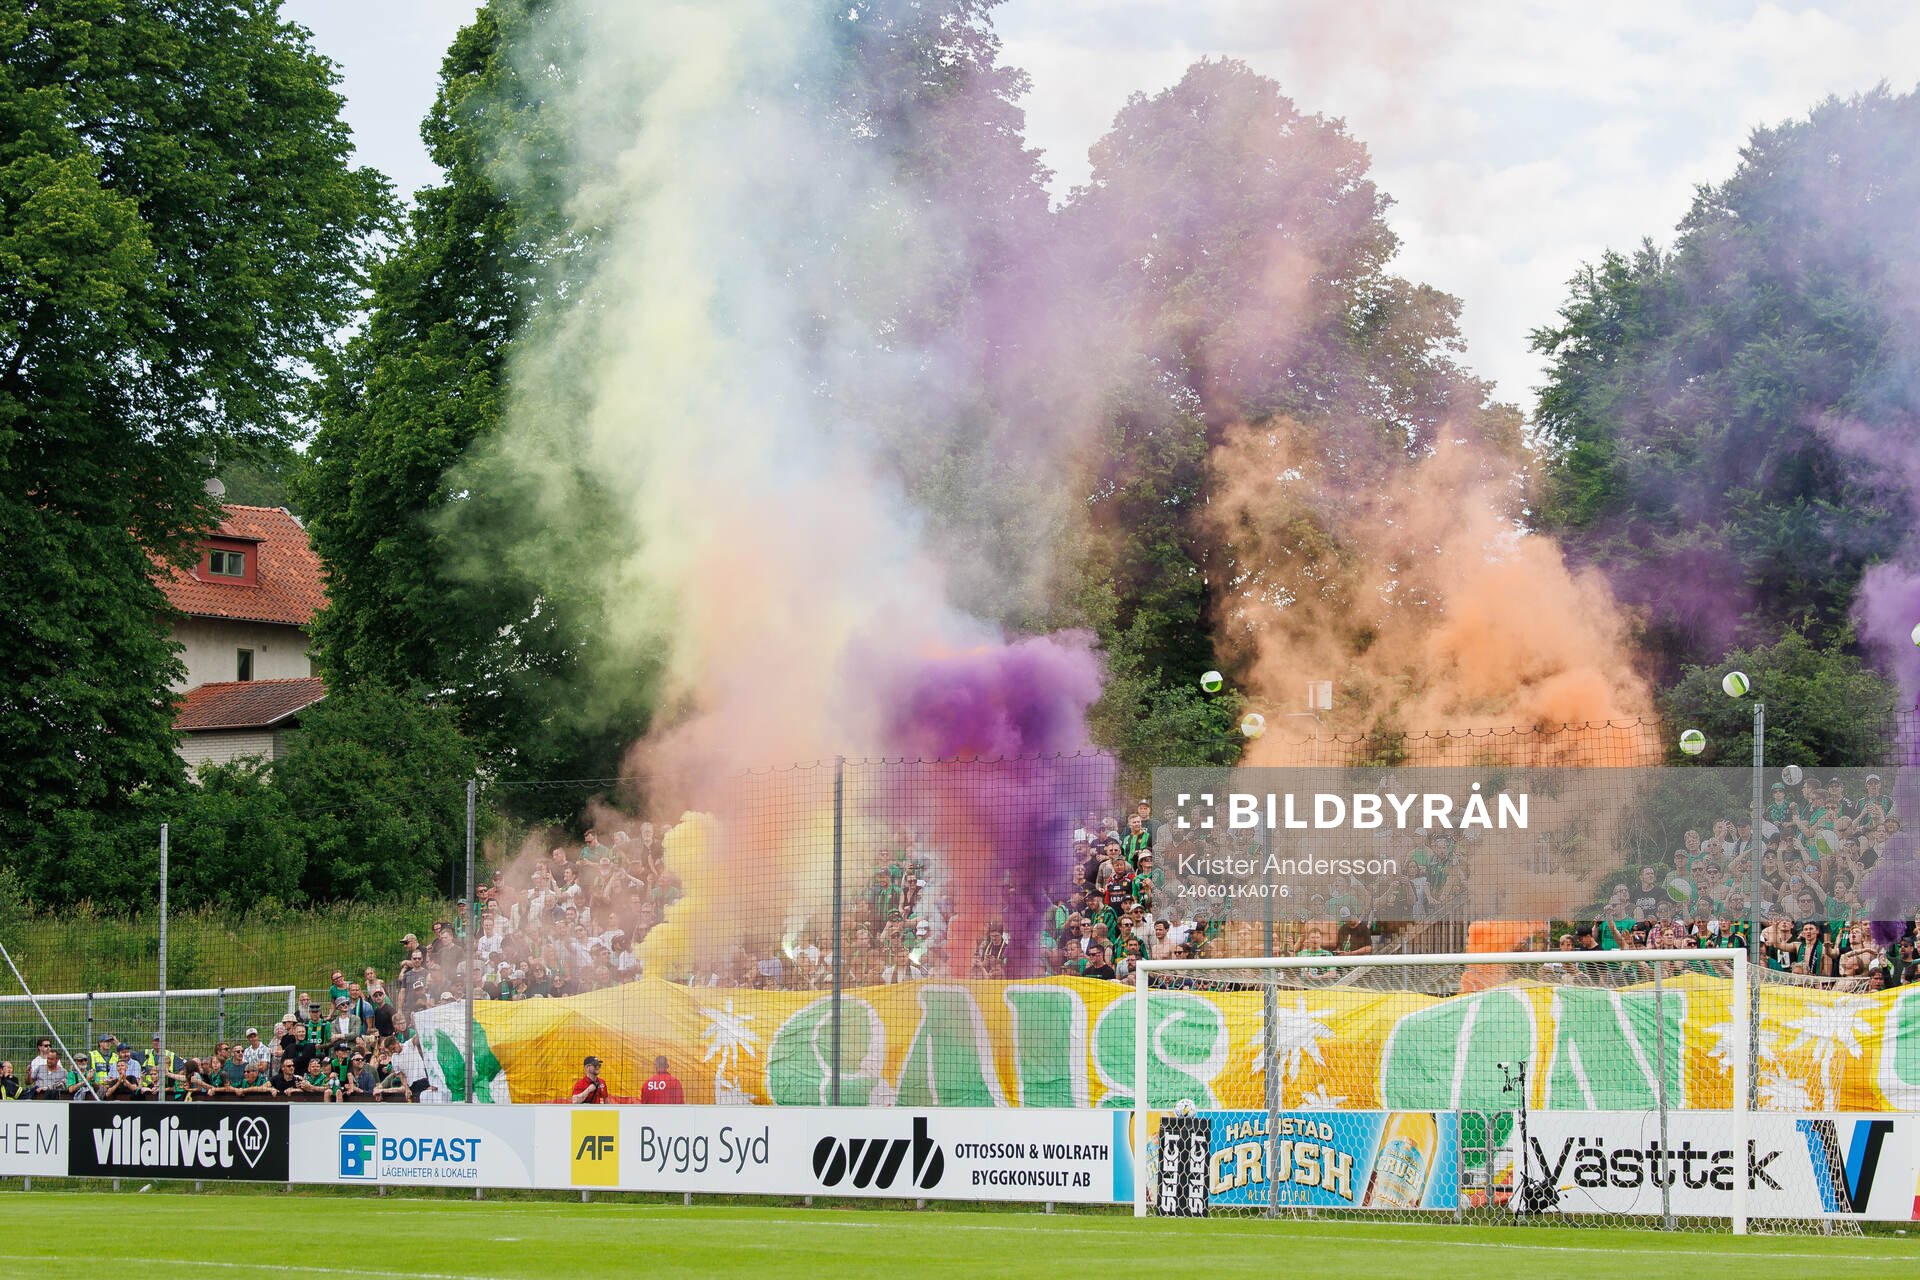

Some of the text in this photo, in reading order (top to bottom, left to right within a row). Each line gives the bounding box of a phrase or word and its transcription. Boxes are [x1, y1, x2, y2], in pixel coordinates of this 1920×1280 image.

[647, 1080, 666, 1091] SLO
[93, 1115, 234, 1168] villalivet
[341, 1134, 376, 1176] BF
[382, 1137, 481, 1162] BOFAST
[576, 1136, 614, 1160] AF
[640, 1126, 769, 1174] Bygg Syd
[955, 1143, 1108, 1160] OTTOSSON & WOLRATH
[382, 1166, 478, 1178] LÄGENHETER & LOKALER
[972, 1170, 1091, 1187] BYGGKONSULT AB
[1161, 1131, 1180, 1213] SELECT
[1188, 1132, 1206, 1213] SELECT
[1209, 1140, 1353, 1201] CRUSH
[1529, 1136, 1784, 1191] Västtak
[1248, 1189, 1311, 1203] ALKOLFRI
